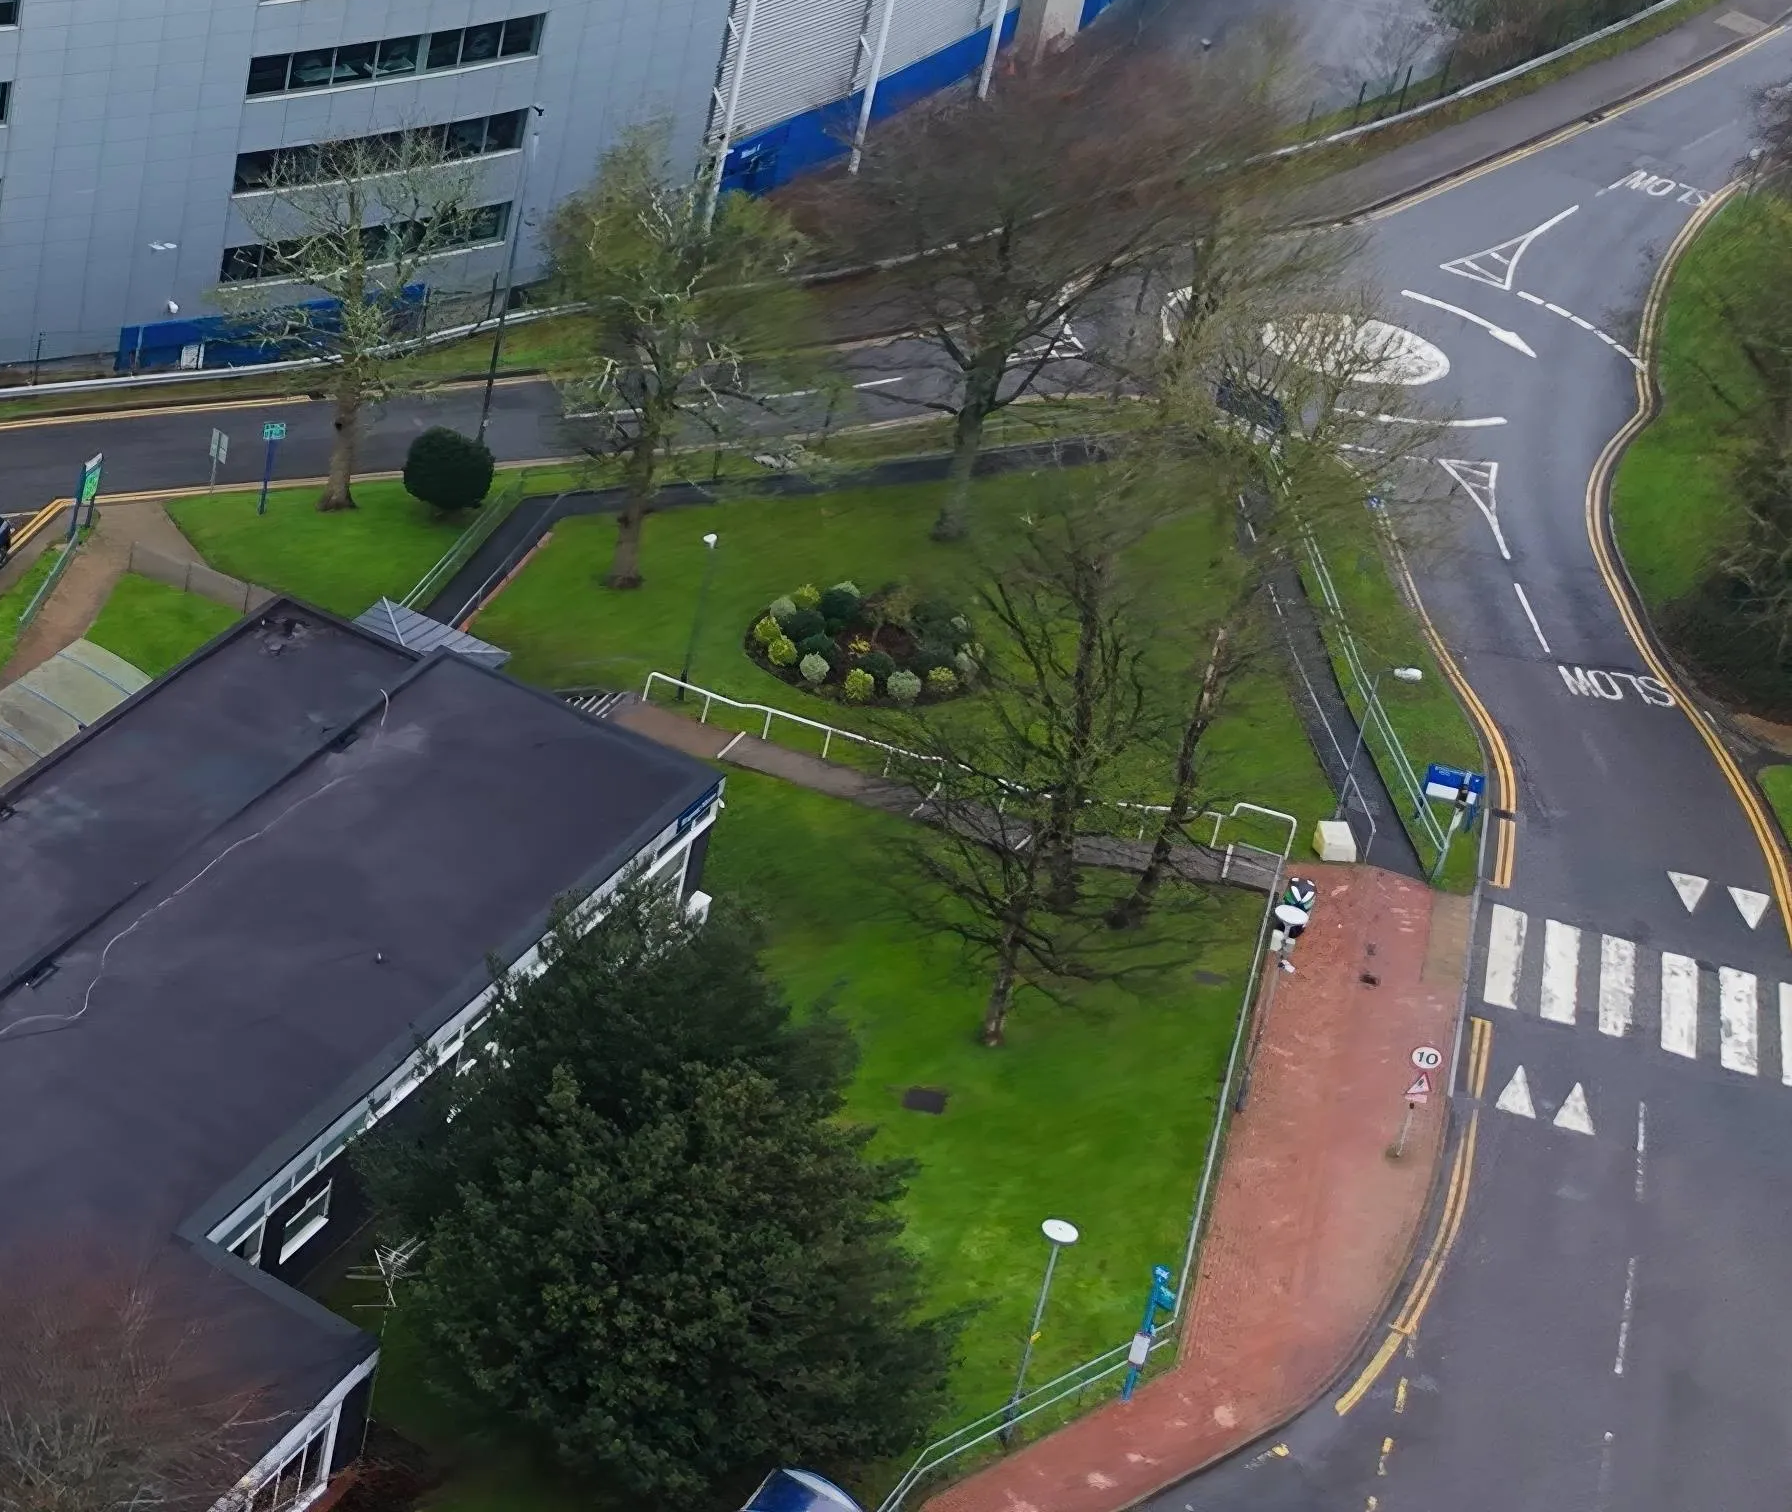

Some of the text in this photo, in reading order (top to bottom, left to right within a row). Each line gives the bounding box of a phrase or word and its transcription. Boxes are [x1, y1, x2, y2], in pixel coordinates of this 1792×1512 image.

[1608, 169, 1713, 206] SLOW
[1558, 665, 1676, 707] SLOW
[1418, 1051, 1438, 1065] 10
